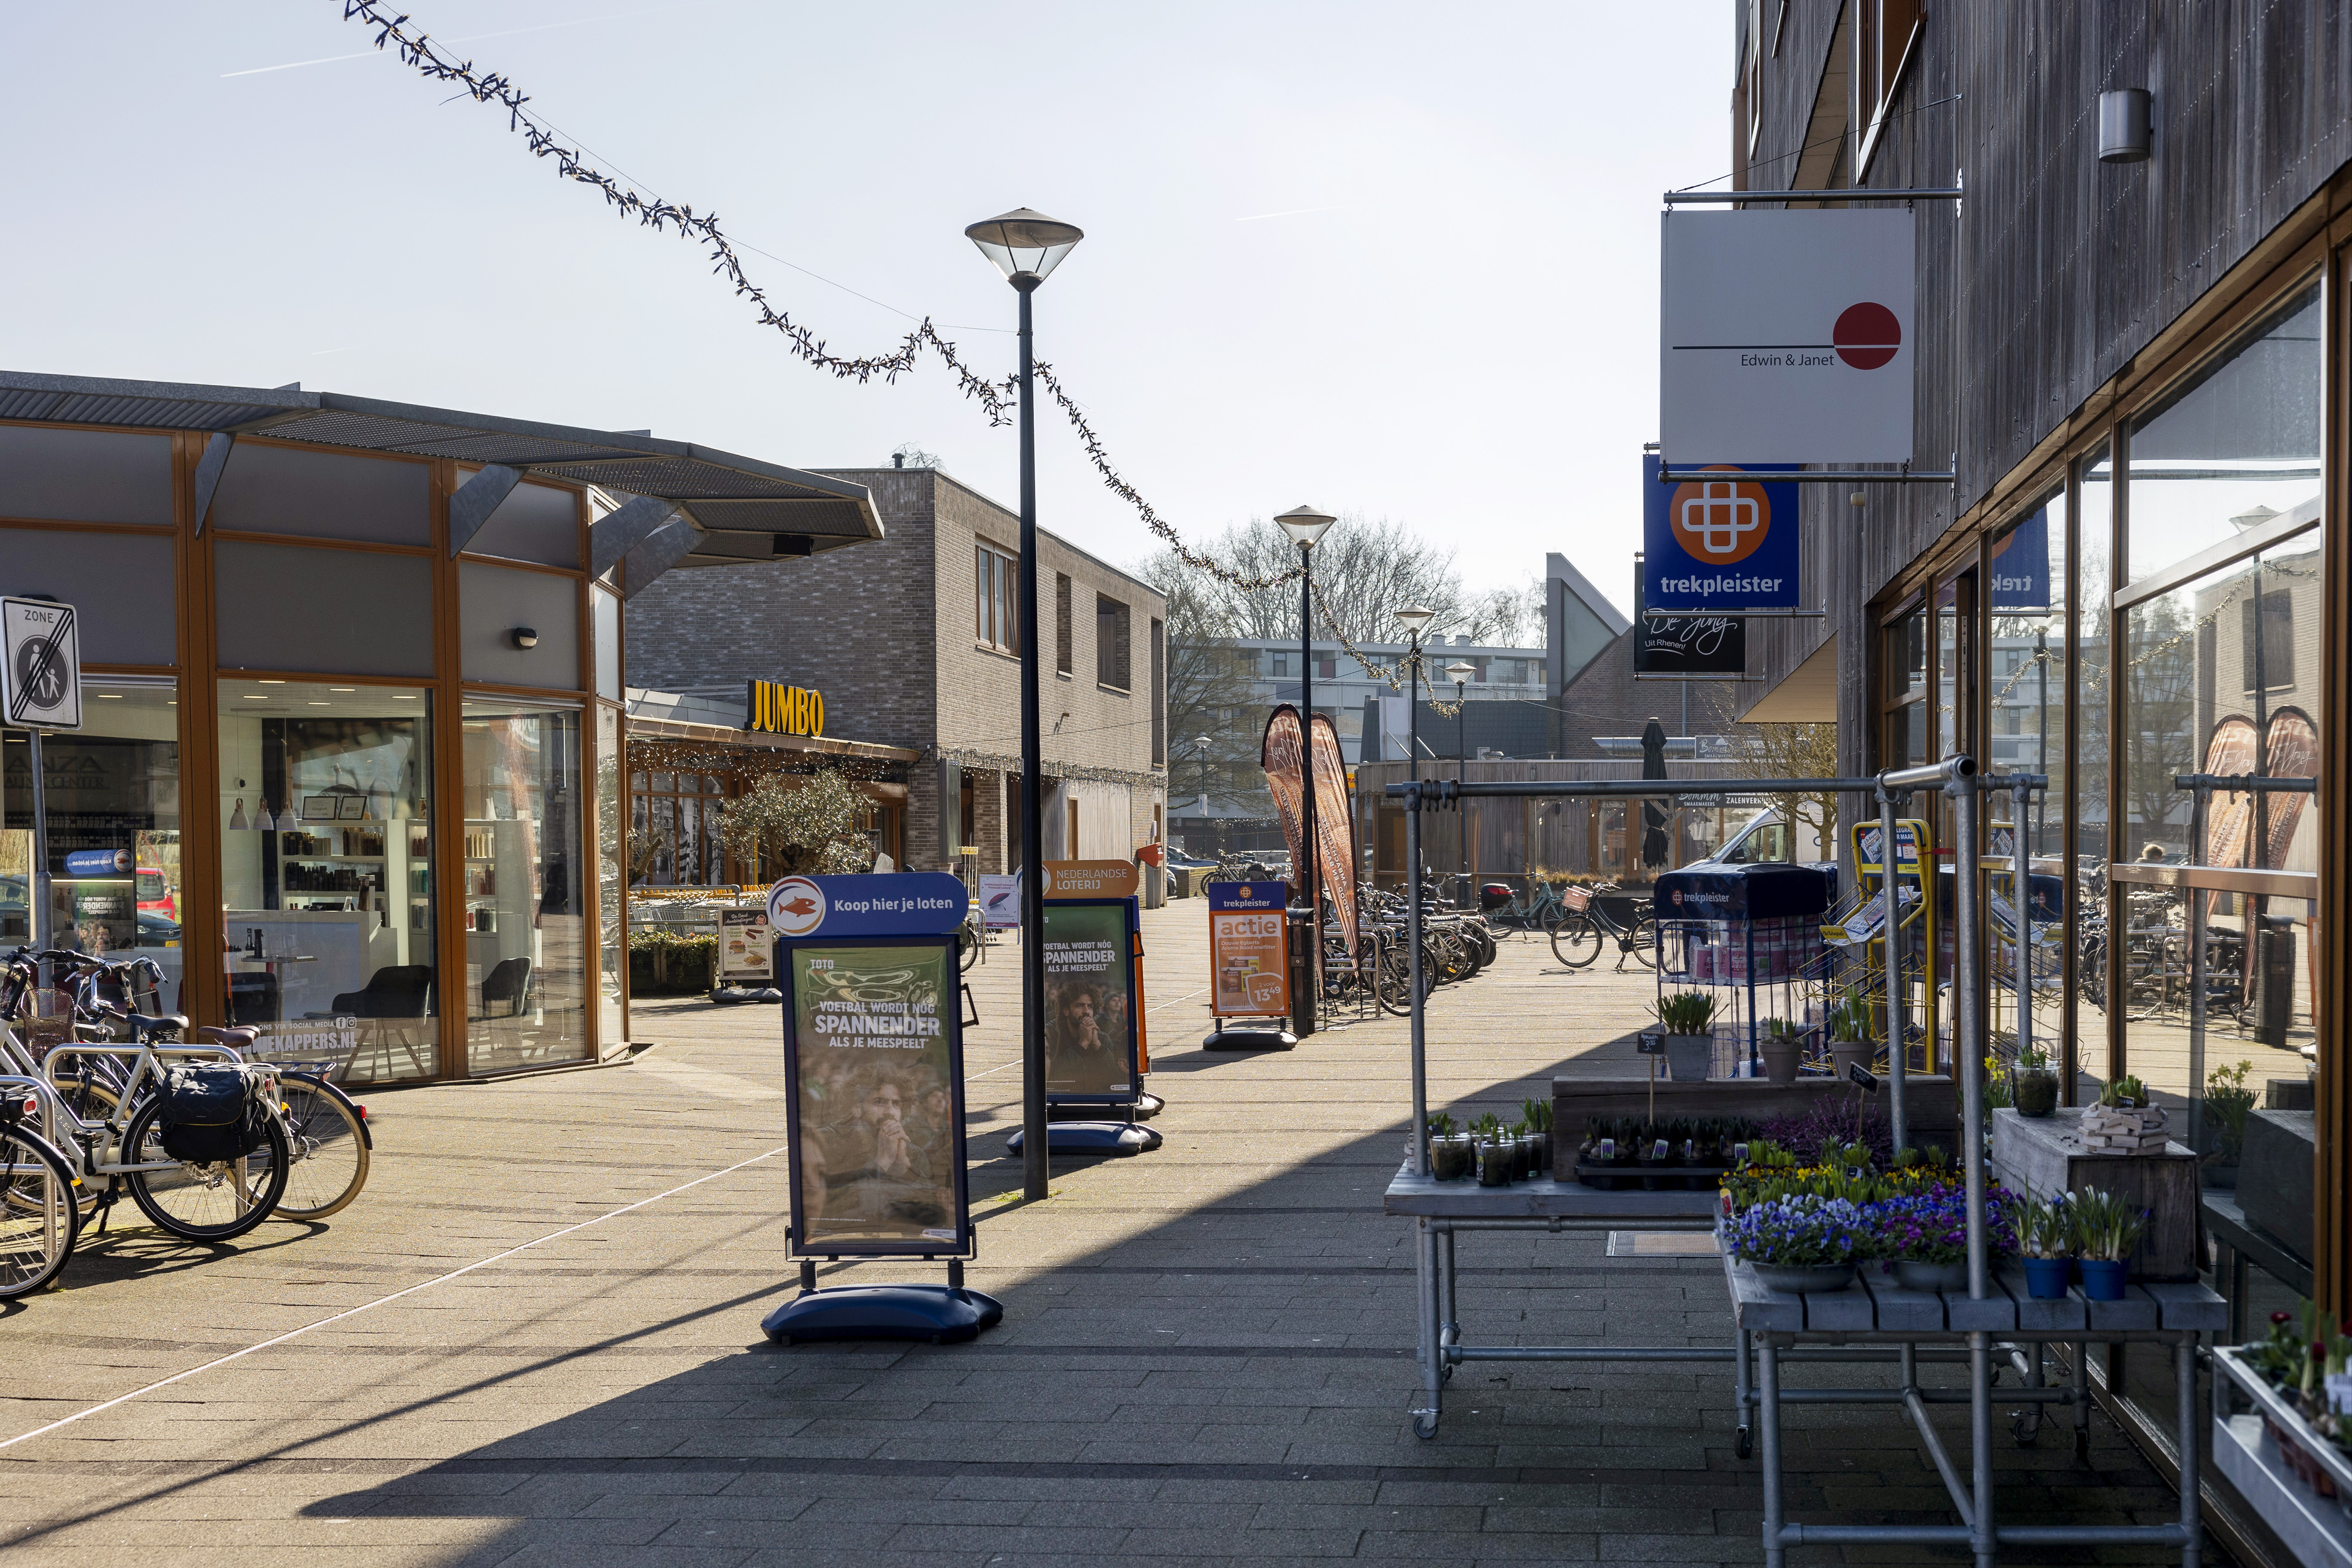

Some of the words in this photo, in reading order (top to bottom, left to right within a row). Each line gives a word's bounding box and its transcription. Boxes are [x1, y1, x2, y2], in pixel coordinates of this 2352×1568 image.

[1742, 354, 1781, 366] Edwin
[1785, 354, 1795, 365] &
[1798, 354, 1834, 365] Janet
[1661, 573, 1782, 597] trekpleister
[24, 609, 54, 623] ZONE
[1657, 639, 1686, 650] Rhenen!
[753, 679, 824, 737] JUMBO
[51, 776, 105, 789] CENTER
[1057, 869, 1127, 879] NEDERLANDSE
[1057, 880, 1100, 890] LOTERIJ
[1224, 899, 1270, 908] trekpleister
[1684, 892, 1729, 903] trekpleister
[835, 900, 869, 913] Koop
[873, 898, 898, 910] hier
[901, 897, 914, 913] je
[917, 897, 953, 909] loten
[1221, 916, 1277, 935] actie
[1097, 940, 1112, 948] NÓG
[810, 959, 834, 969] TOTO
[819, 1001, 867, 1013] VOETBAL
[870, 1002, 909, 1013] WORDT
[815, 1015, 940, 1036] SPANNENDER
[829, 1037, 849, 1047] ALS
[852, 1037, 864, 1047] JE
